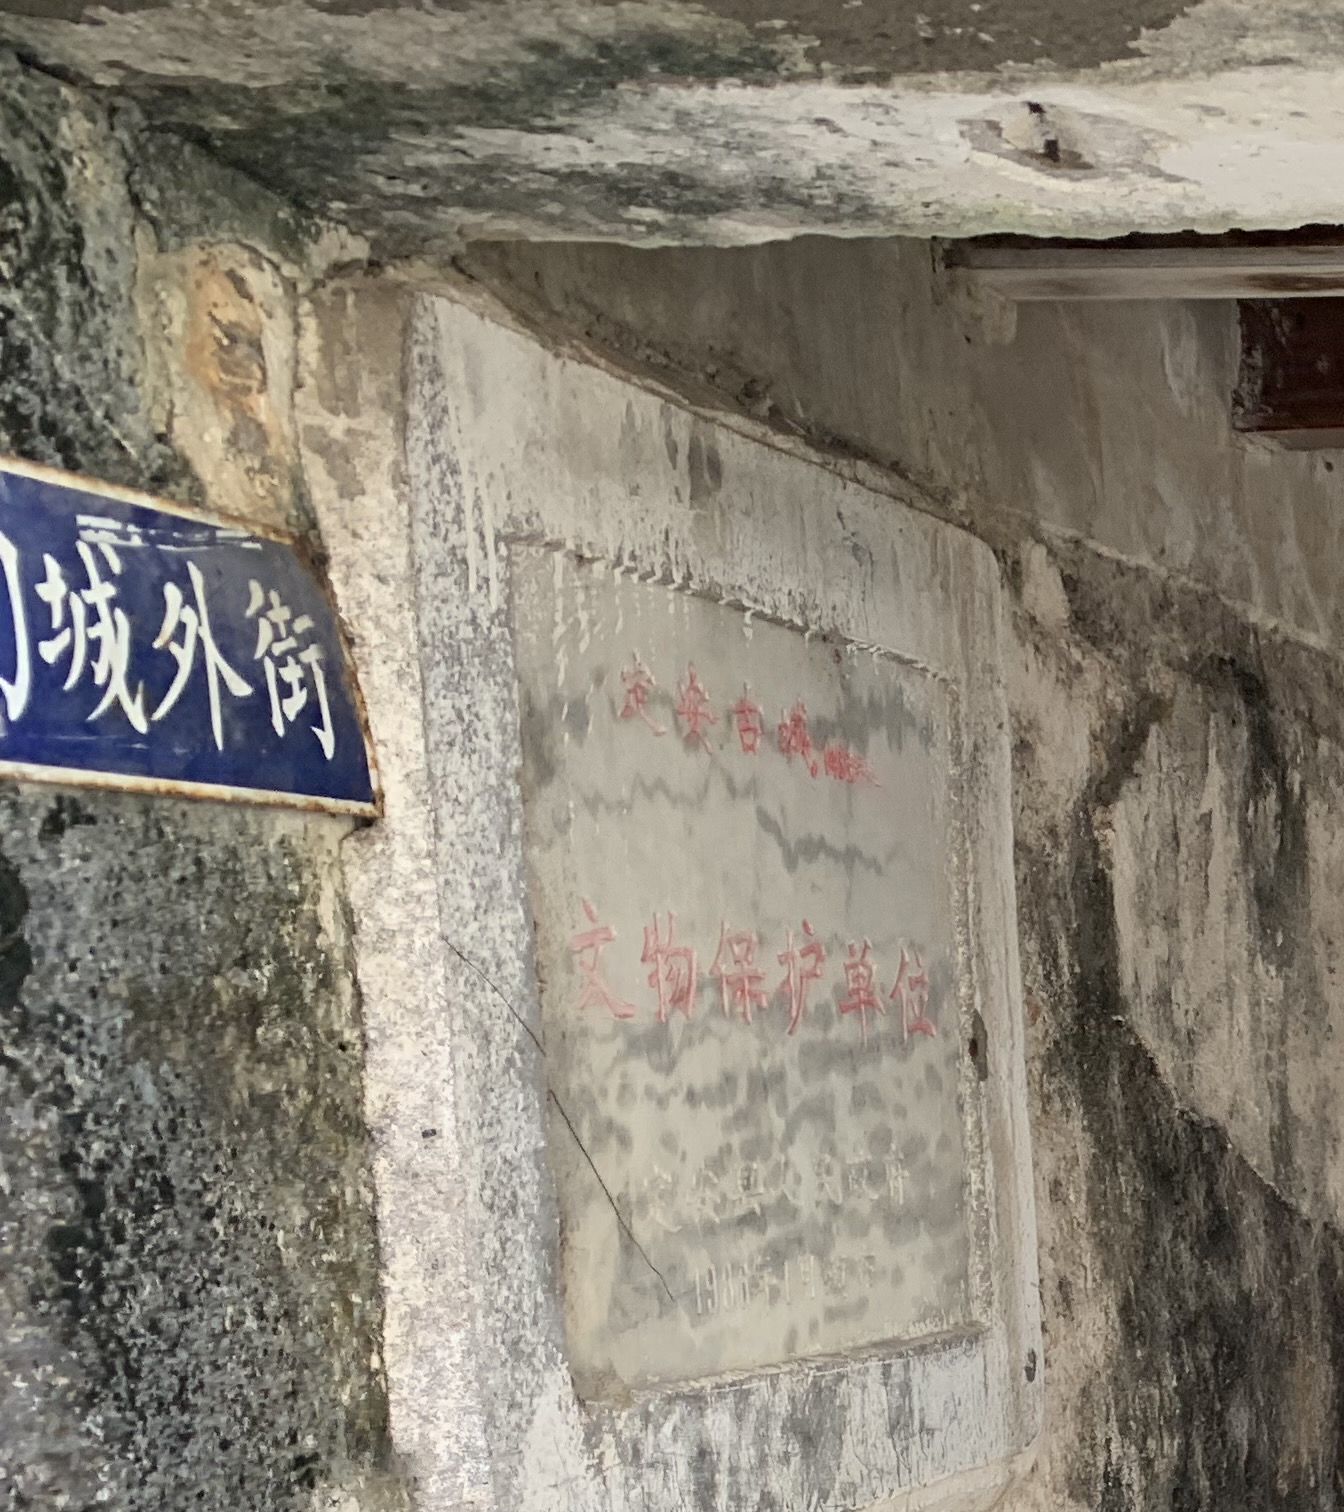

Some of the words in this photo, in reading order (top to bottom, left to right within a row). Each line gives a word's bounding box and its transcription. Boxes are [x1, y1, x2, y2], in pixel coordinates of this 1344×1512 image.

[571, 898, 937, 1048] 文物保护单位
